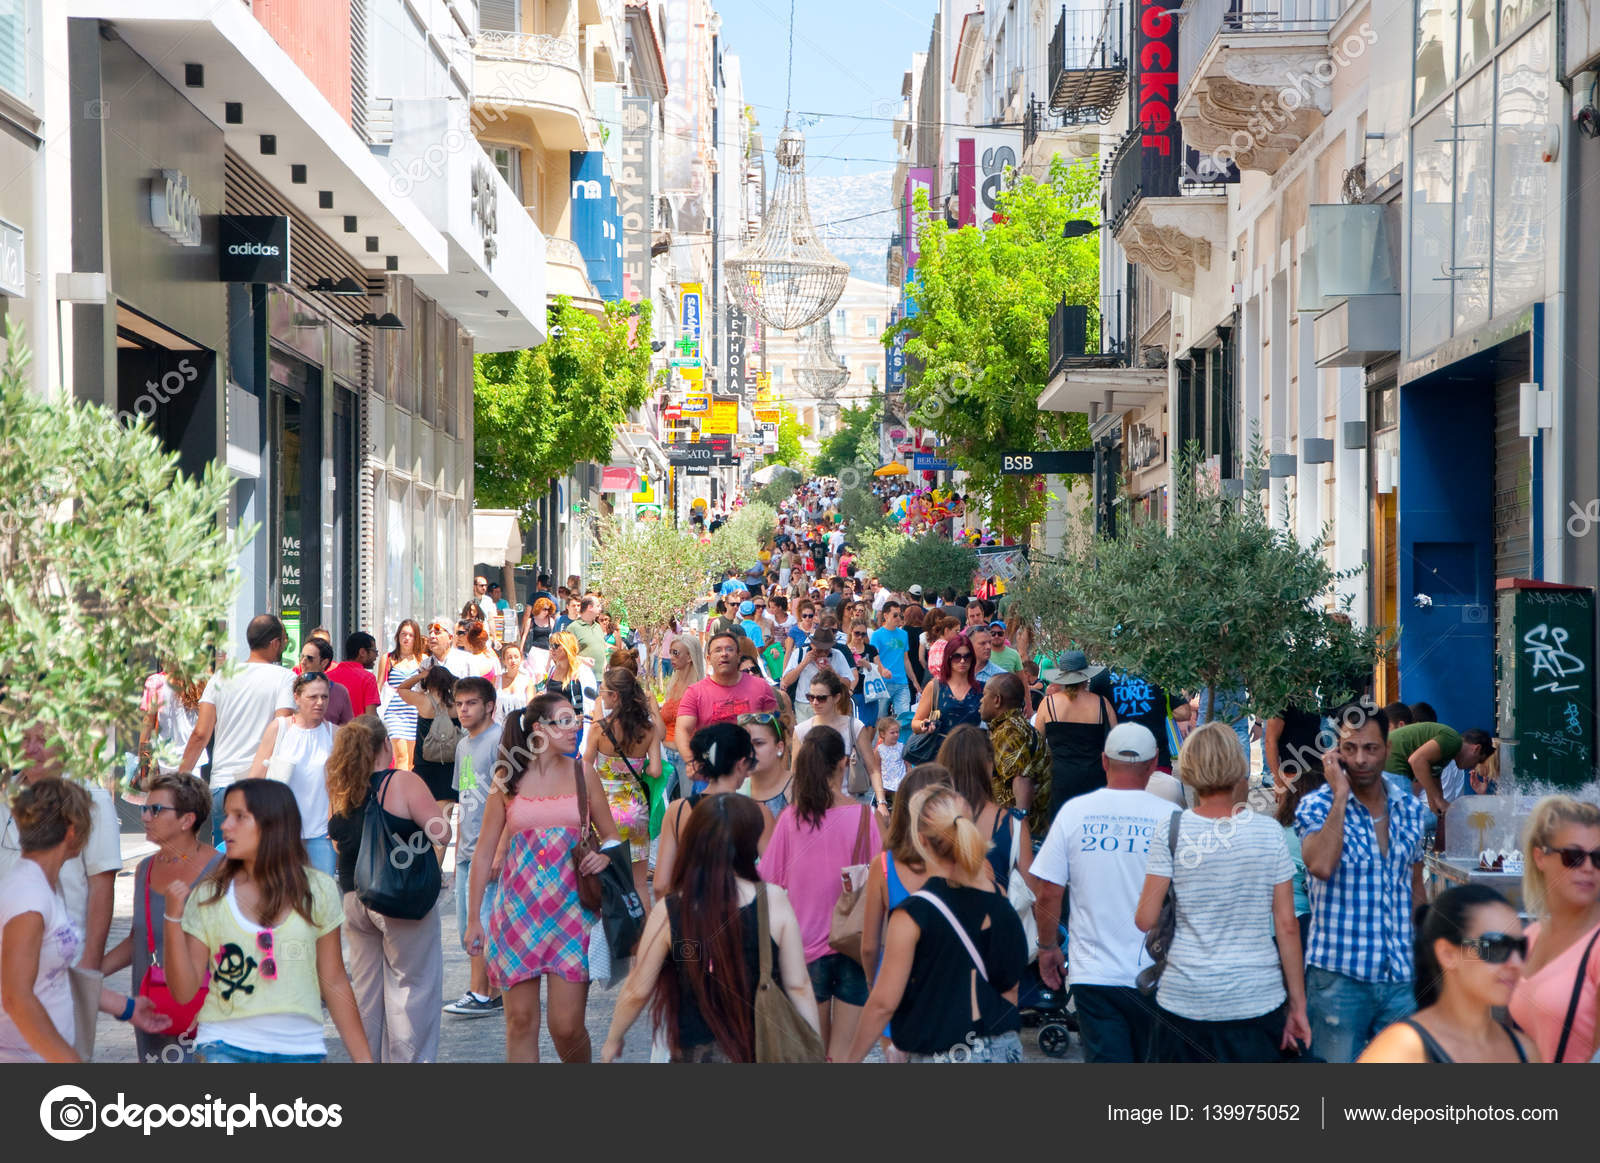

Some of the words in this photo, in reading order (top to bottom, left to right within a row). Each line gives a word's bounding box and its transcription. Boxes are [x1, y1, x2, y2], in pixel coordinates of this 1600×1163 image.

[1140, 0, 1178, 156] ocker
[228, 242, 279, 256] adidas
[729, 308, 740, 388] SEPHORA
[1004, 456, 1034, 470] BSB
[282, 536, 300, 549] Me
[282, 565, 300, 578] Me
[1113, 685, 1156, 704] FORCE
[1082, 823, 1109, 836] YCP
